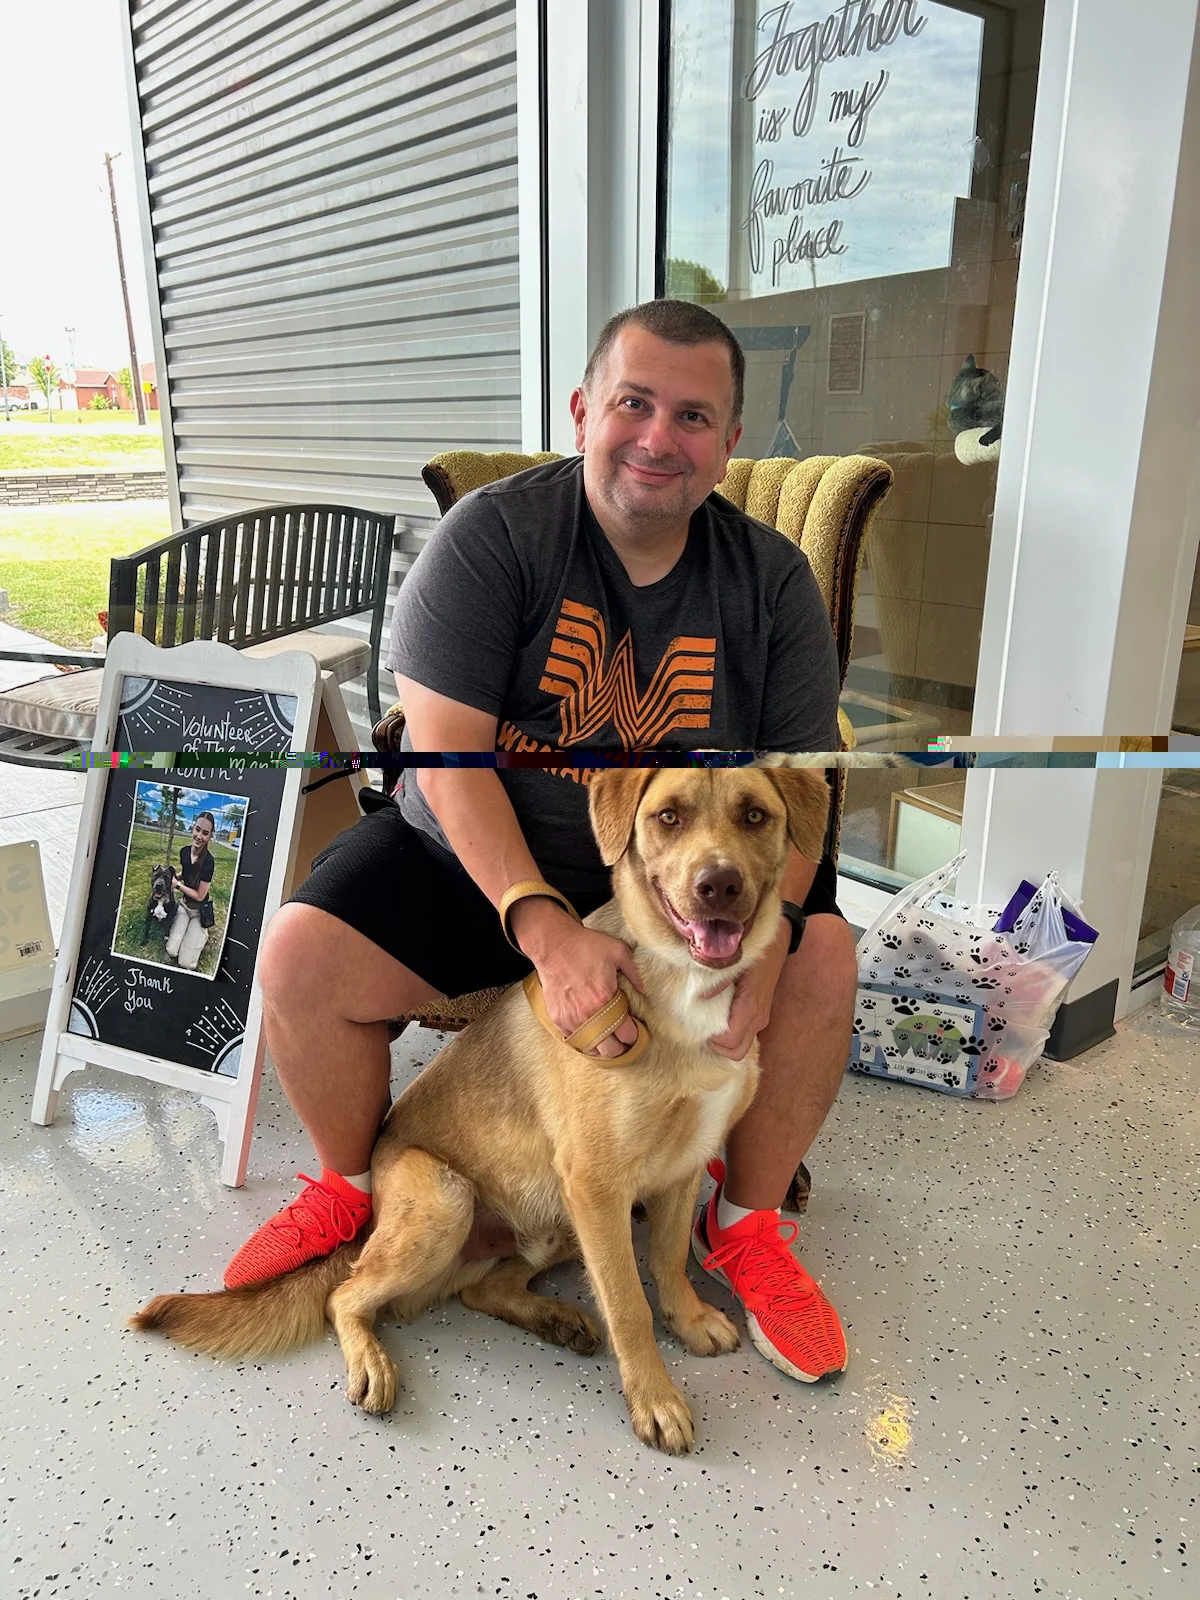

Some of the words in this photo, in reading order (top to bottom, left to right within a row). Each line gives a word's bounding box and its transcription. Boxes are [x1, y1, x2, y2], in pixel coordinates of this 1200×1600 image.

[743, 0, 926, 136] Together
[756, 108, 789, 143] is
[829, 70, 888, 147] my
[741, 147, 870, 274] favorite
[773, 216, 848, 287] place
[124, 968, 174, 994] Thank
[124, 988, 153, 1014] You
